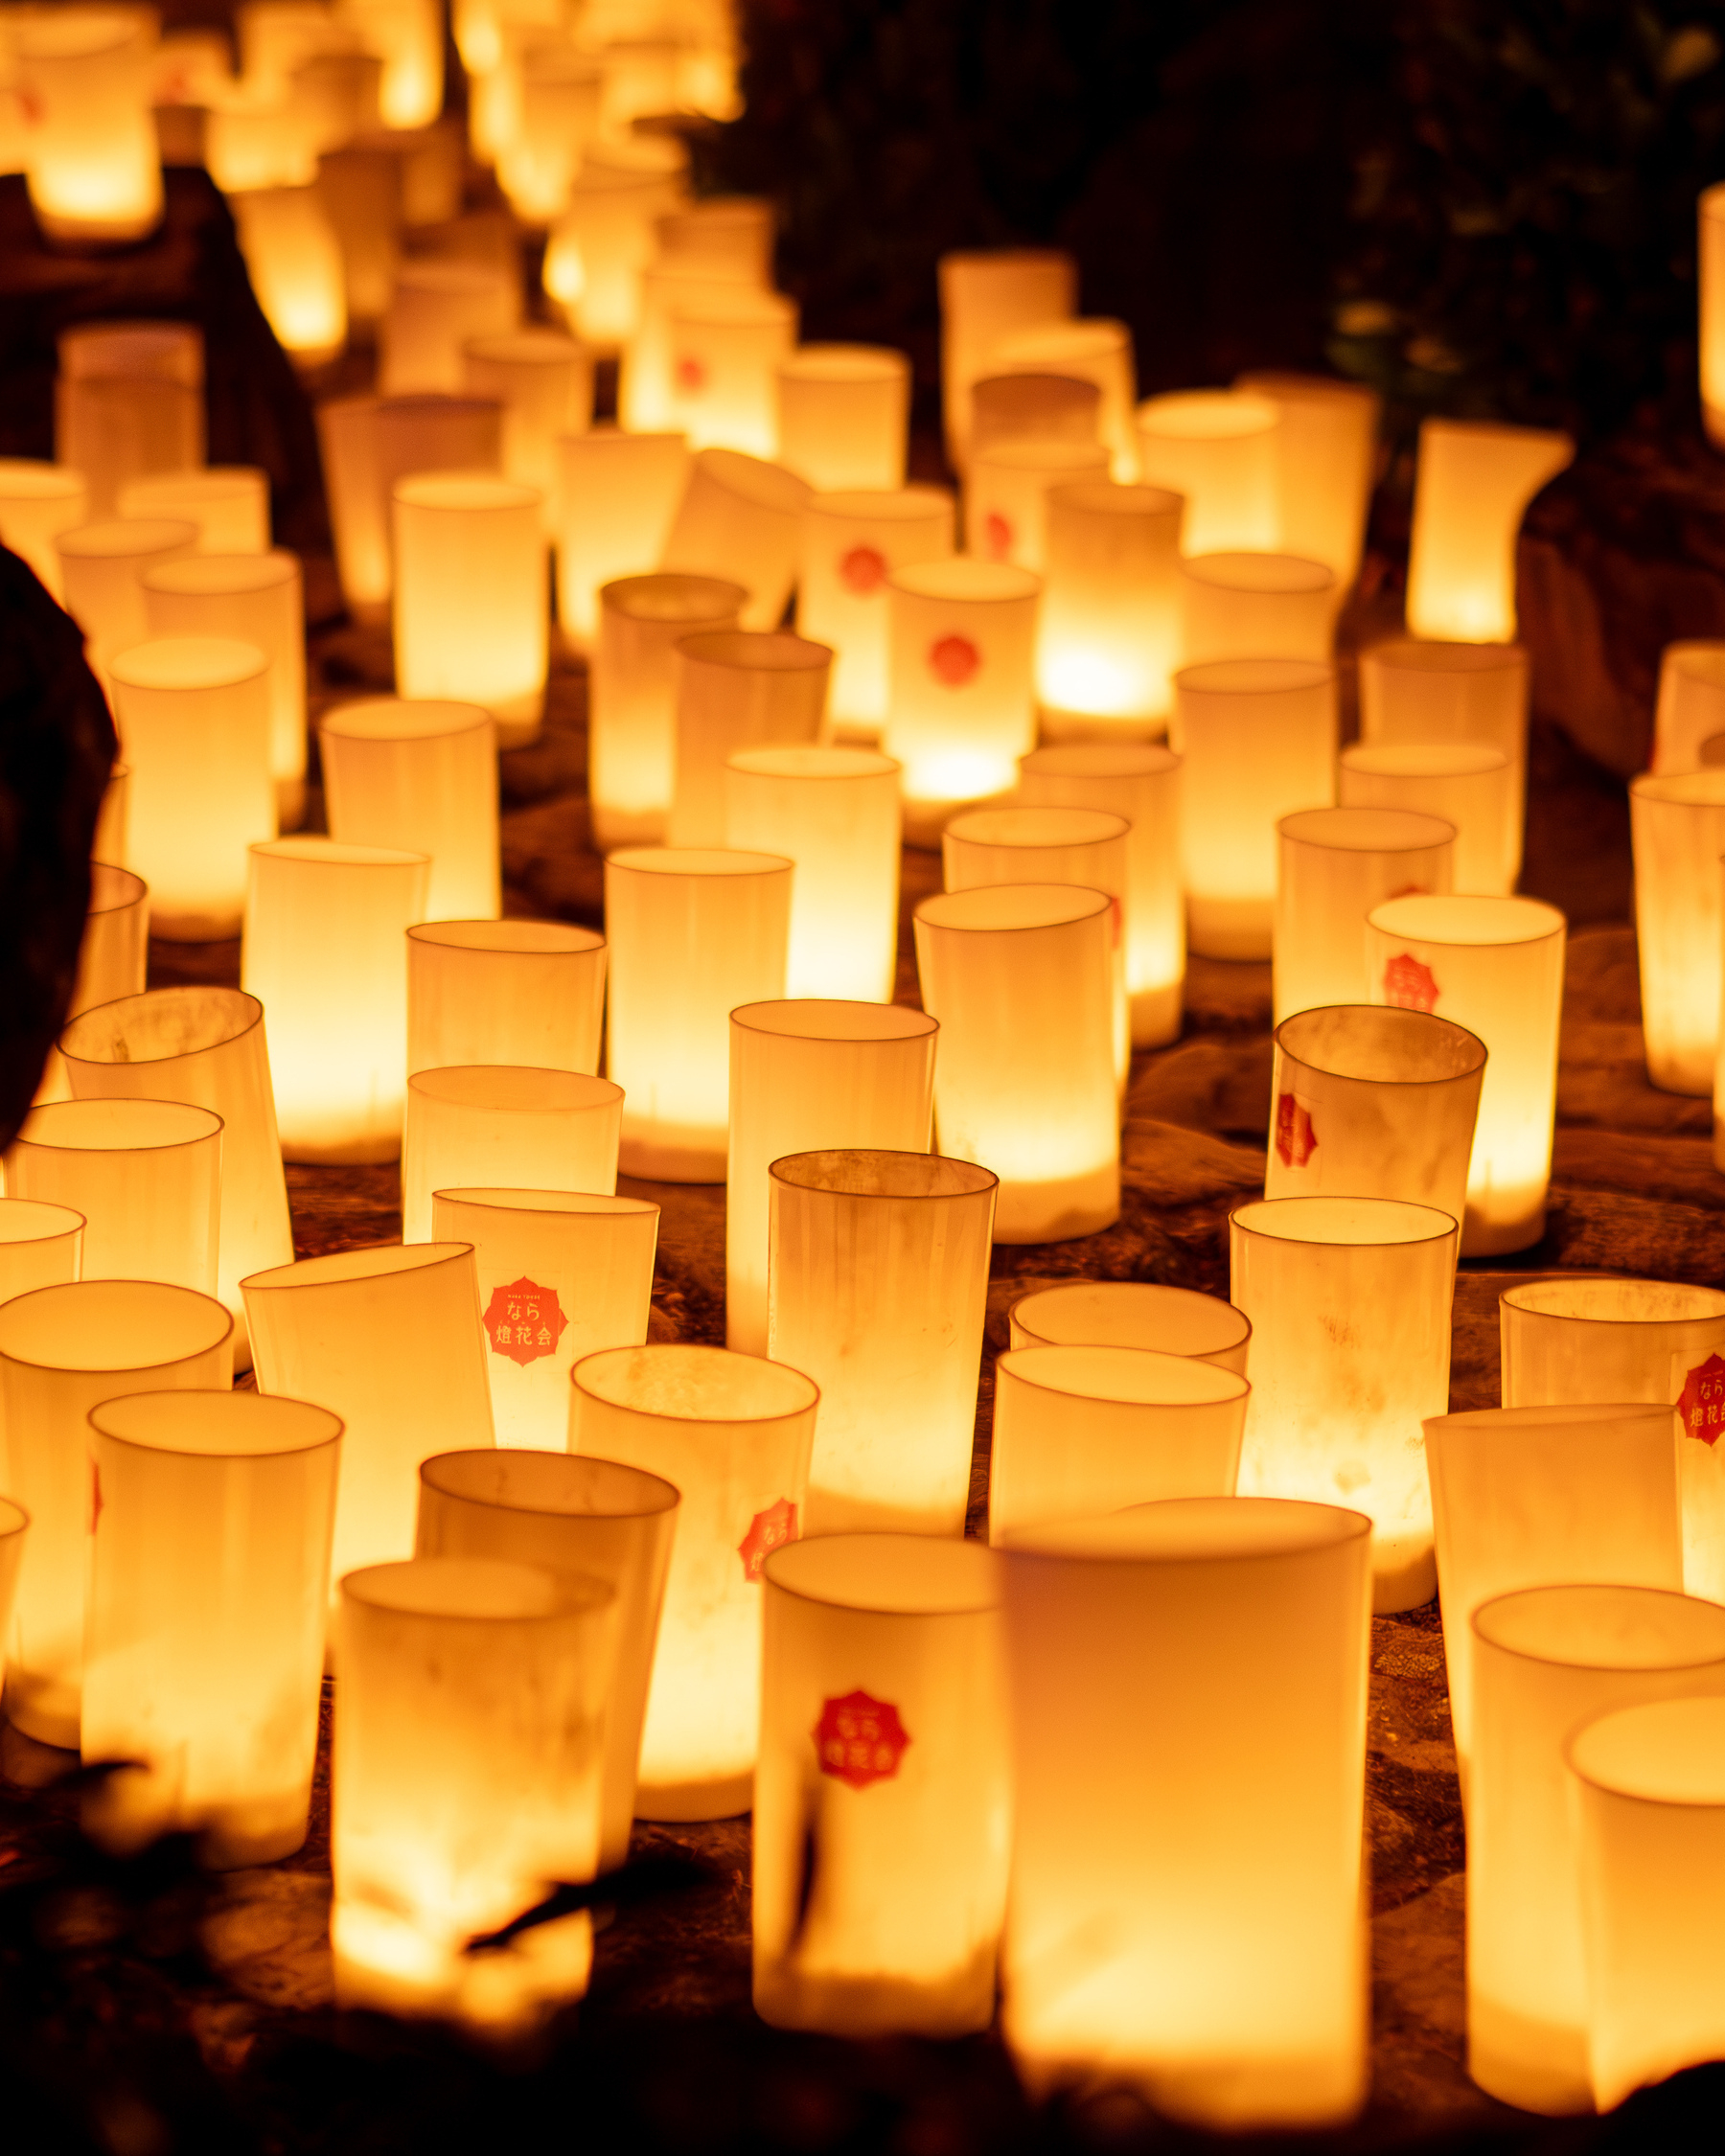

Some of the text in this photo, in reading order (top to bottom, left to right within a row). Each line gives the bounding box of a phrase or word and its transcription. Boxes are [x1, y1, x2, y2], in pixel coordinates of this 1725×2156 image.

[507, 1301, 540, 1321] なら
[495, 1324, 552, 1346] 燈花会
[1700, 1379, 1723, 1400] なら
